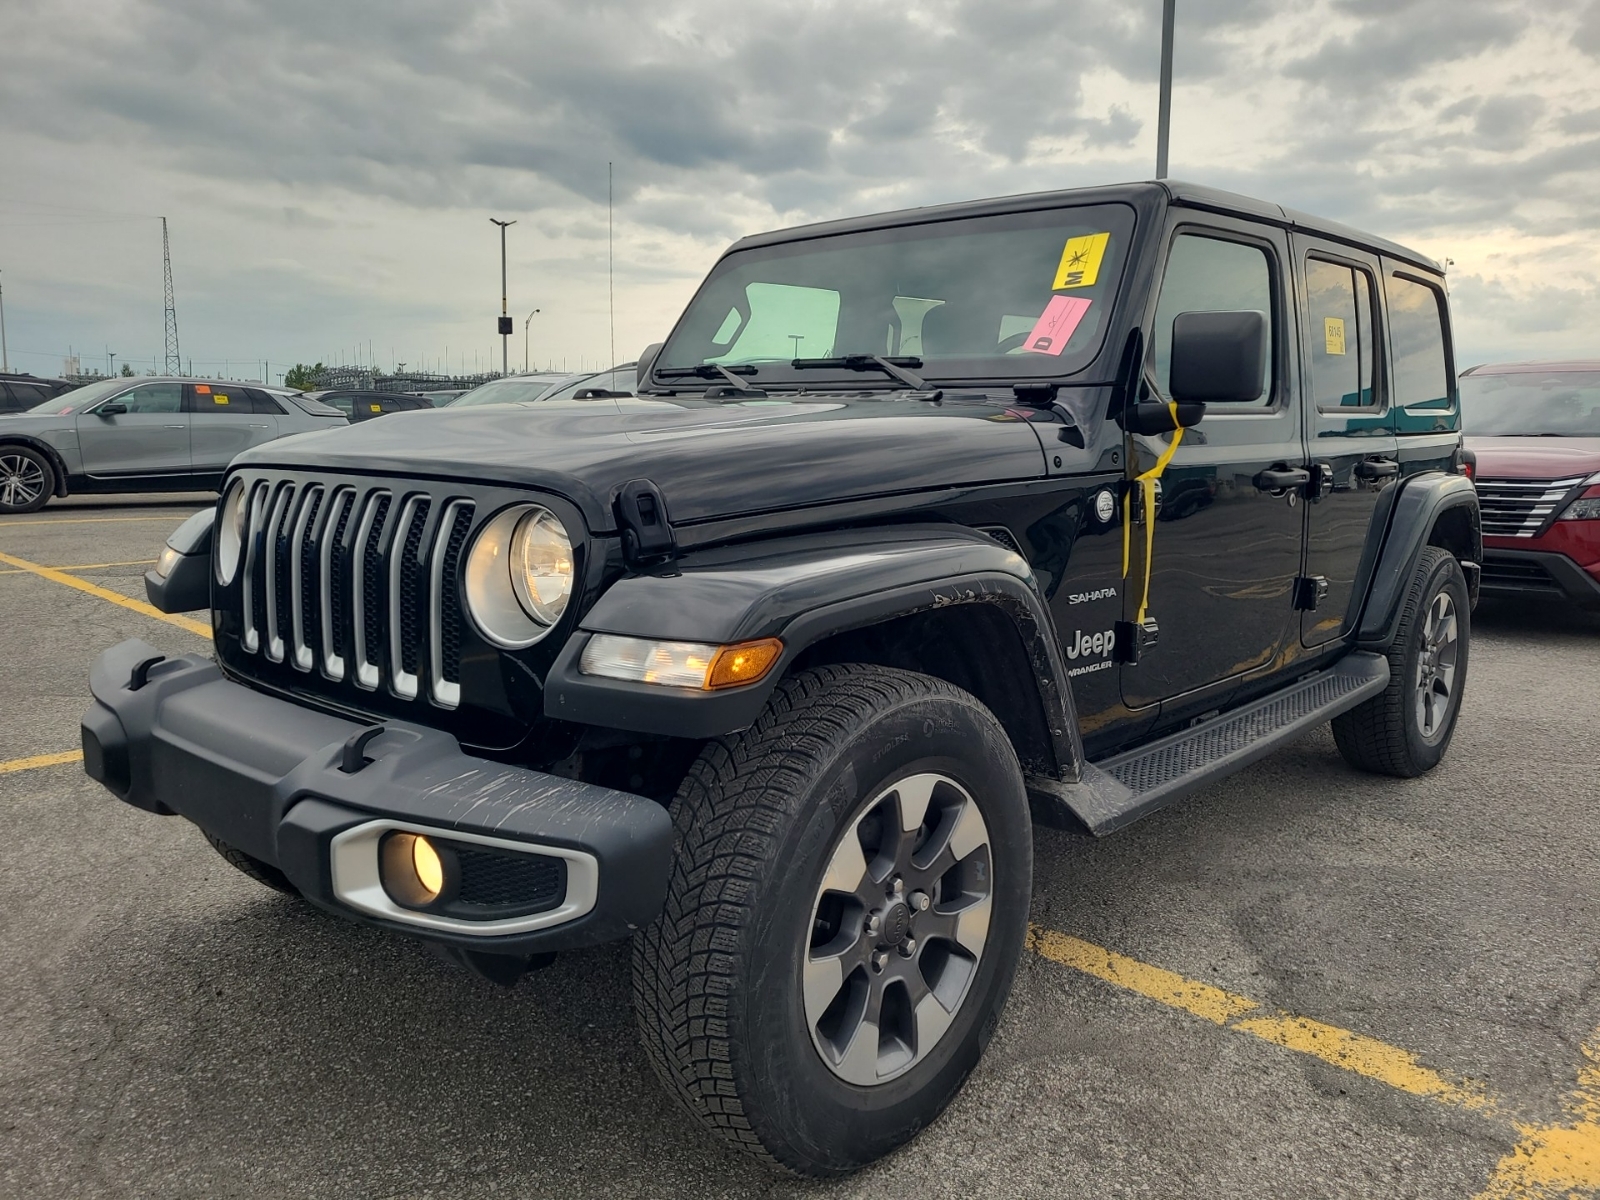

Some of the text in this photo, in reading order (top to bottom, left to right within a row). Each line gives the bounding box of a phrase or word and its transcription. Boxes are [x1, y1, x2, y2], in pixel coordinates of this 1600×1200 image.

[1064, 270, 1085, 286] M
[1032, 336, 1053, 351] D
[1068, 587, 1117, 605] SAHARA
[1066, 629, 1116, 660] Jeep
